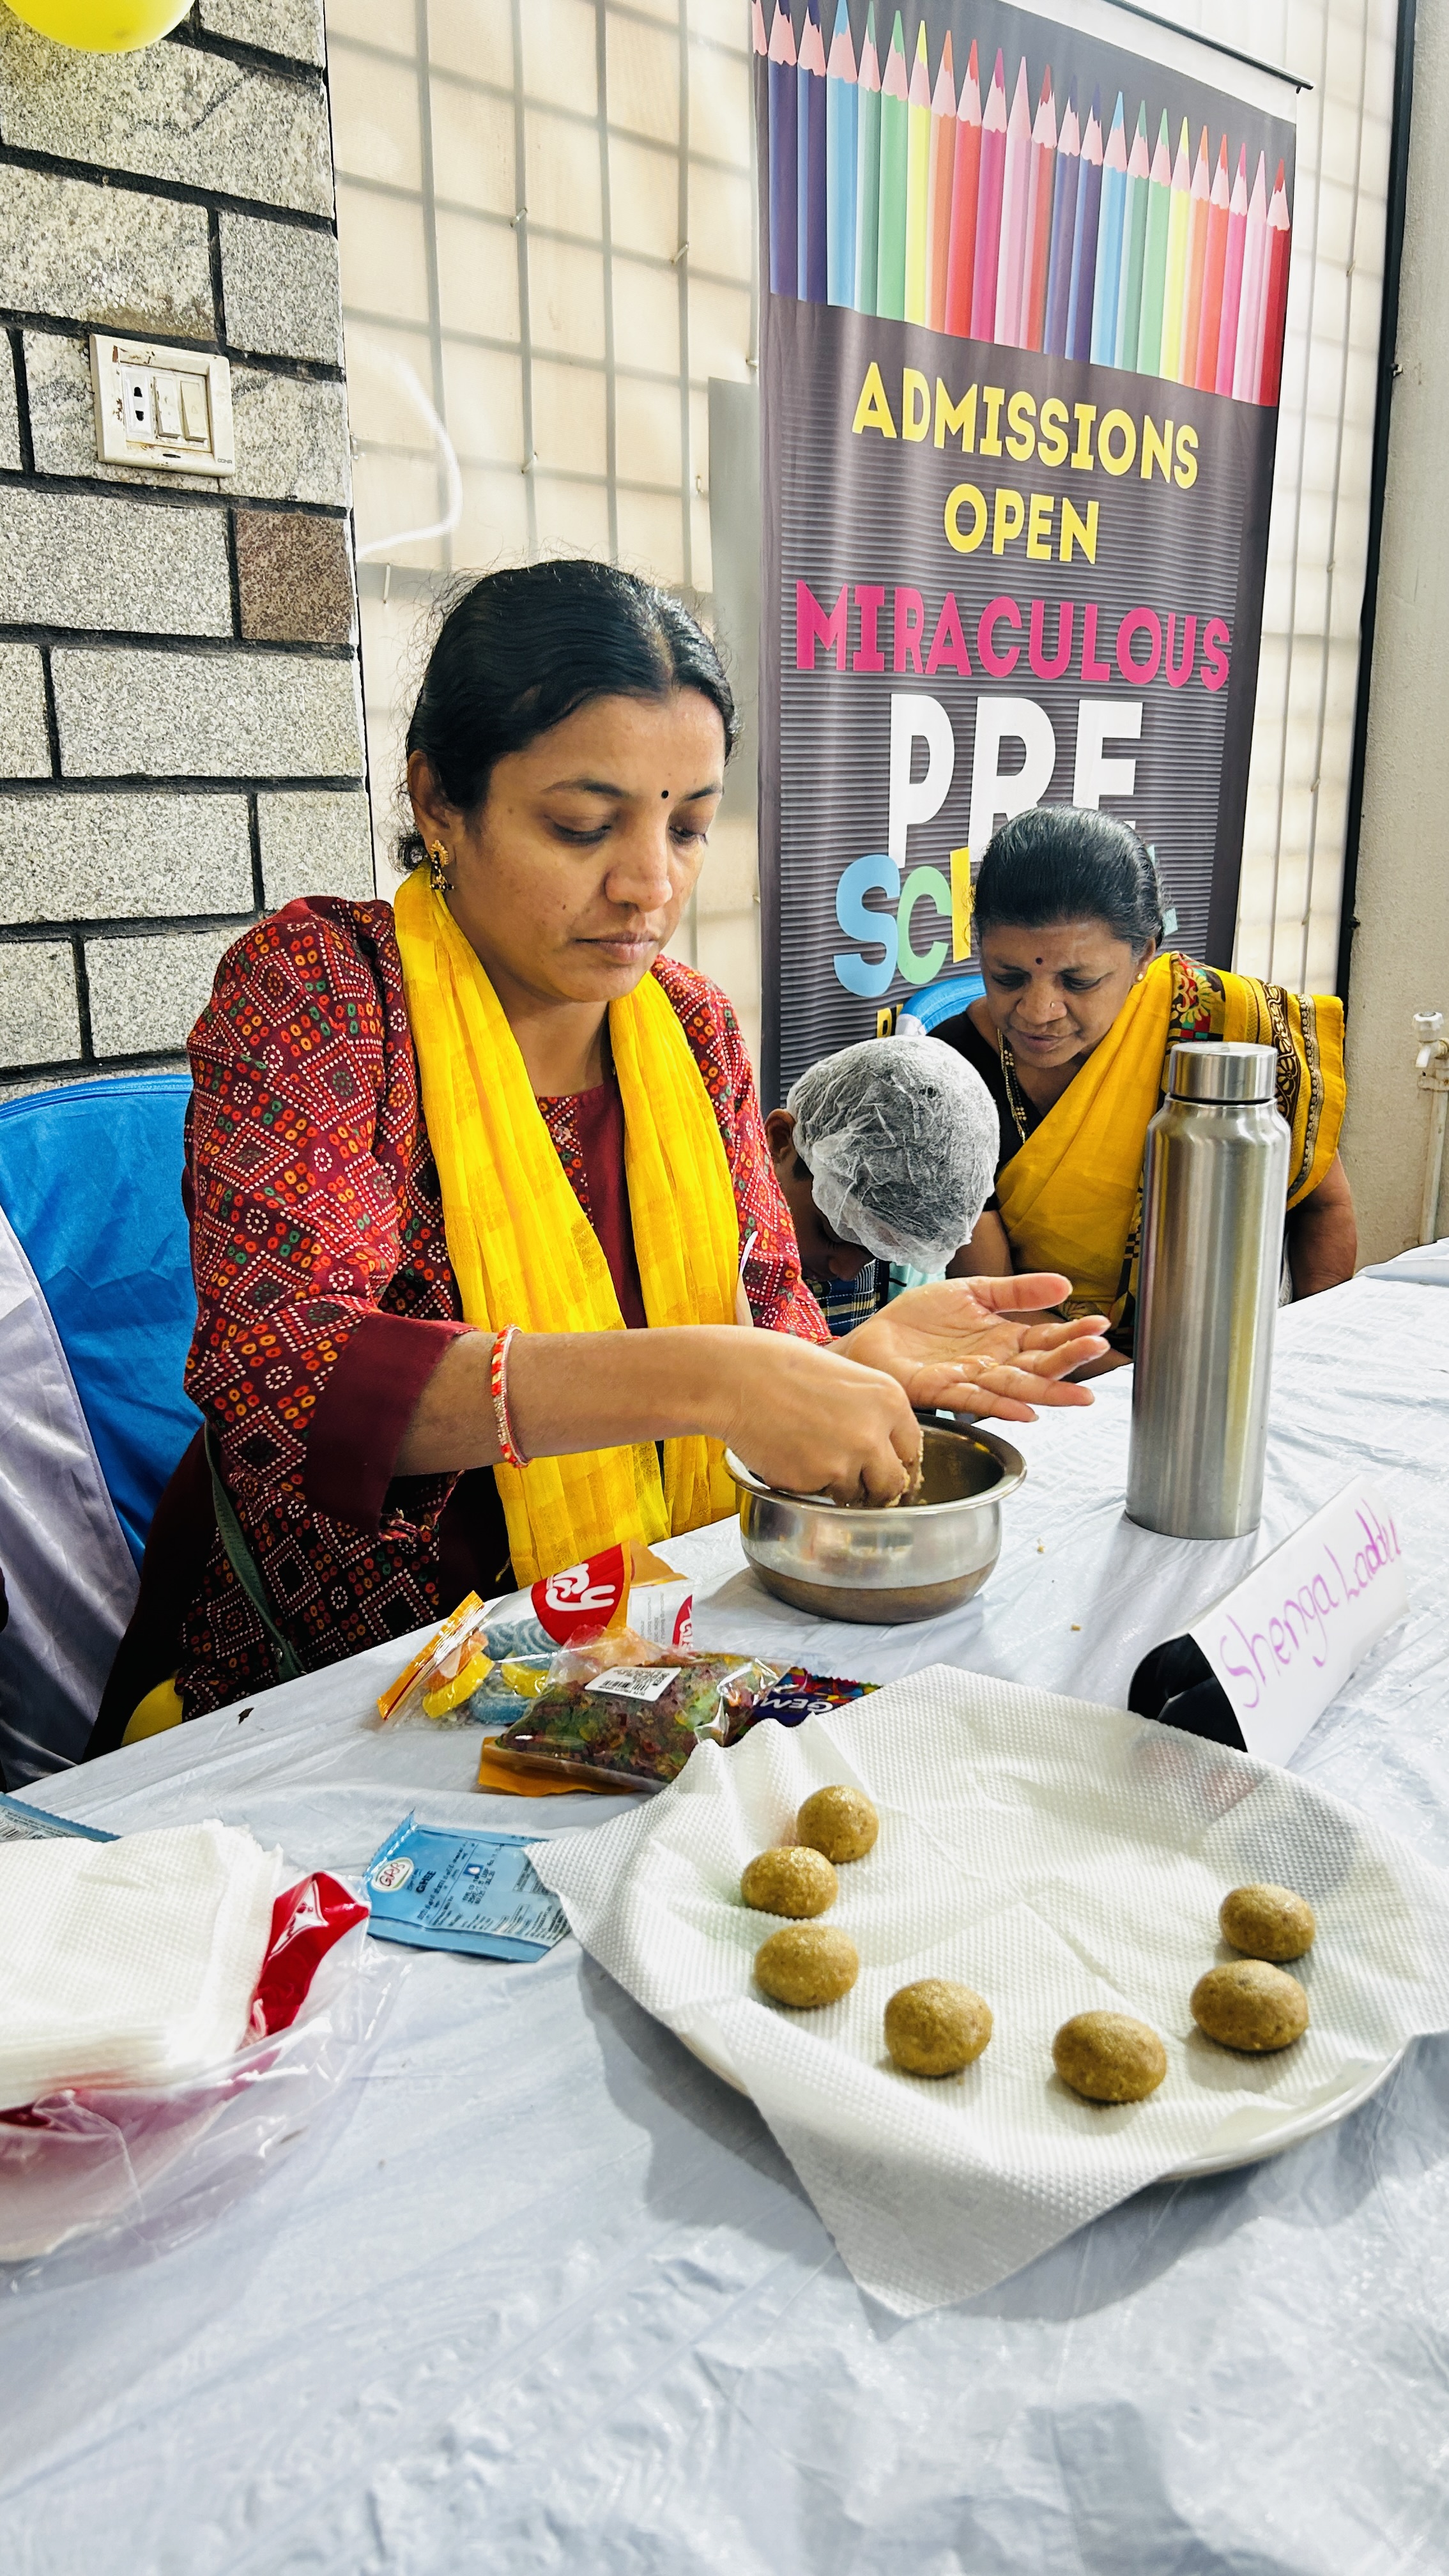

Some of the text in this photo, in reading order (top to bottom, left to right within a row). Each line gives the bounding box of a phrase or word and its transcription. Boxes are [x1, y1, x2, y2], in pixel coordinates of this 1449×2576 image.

[852, 362, 1198, 489] ADMISSIONS
[944, 483, 1099, 565] OPEN
[796, 579, 1230, 691] MIRACULOUS
[888, 694, 1143, 868] PRE
[1220, 1574, 1339, 1708] Shenga
[415, 1869, 437, 1894] GHEE
